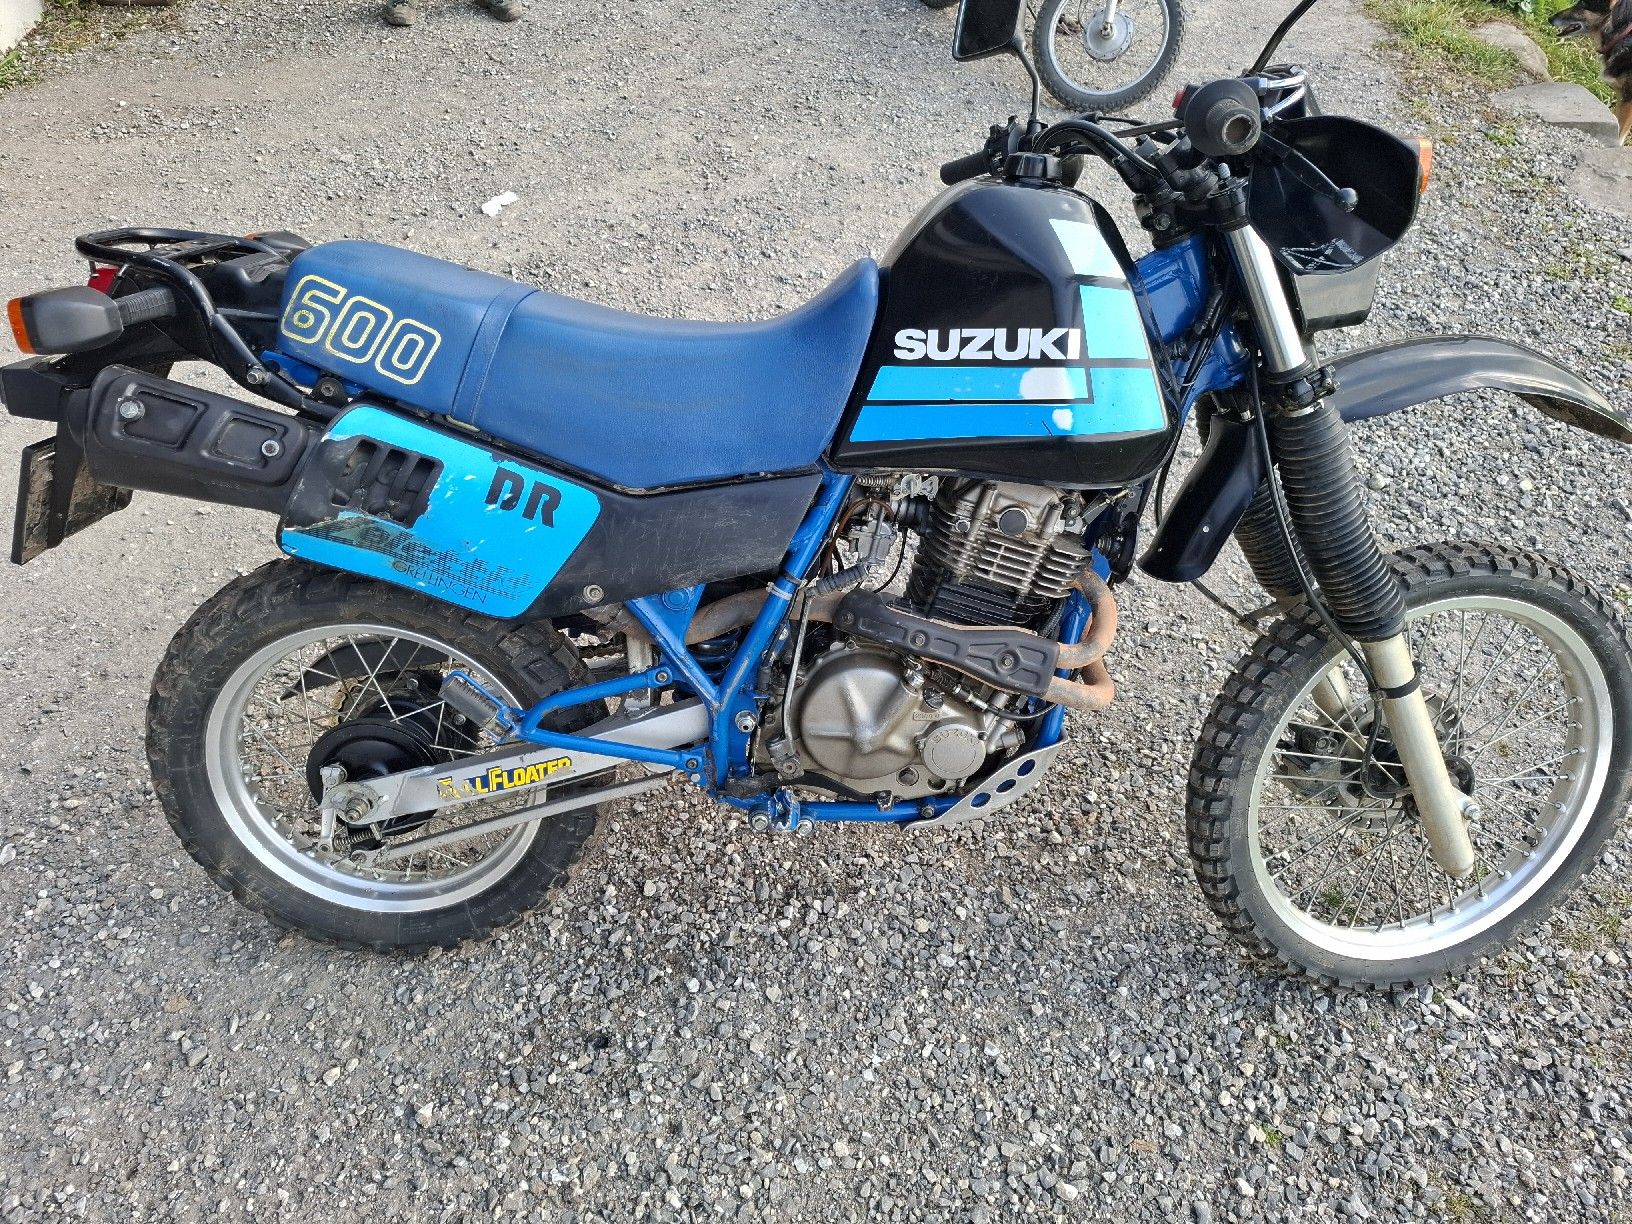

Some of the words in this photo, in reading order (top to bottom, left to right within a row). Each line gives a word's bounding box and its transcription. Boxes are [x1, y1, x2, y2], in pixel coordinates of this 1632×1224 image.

[281, 275, 441, 384] 600
[893, 328, 1081, 361] SUZUKI
[485, 466, 562, 528] DR
